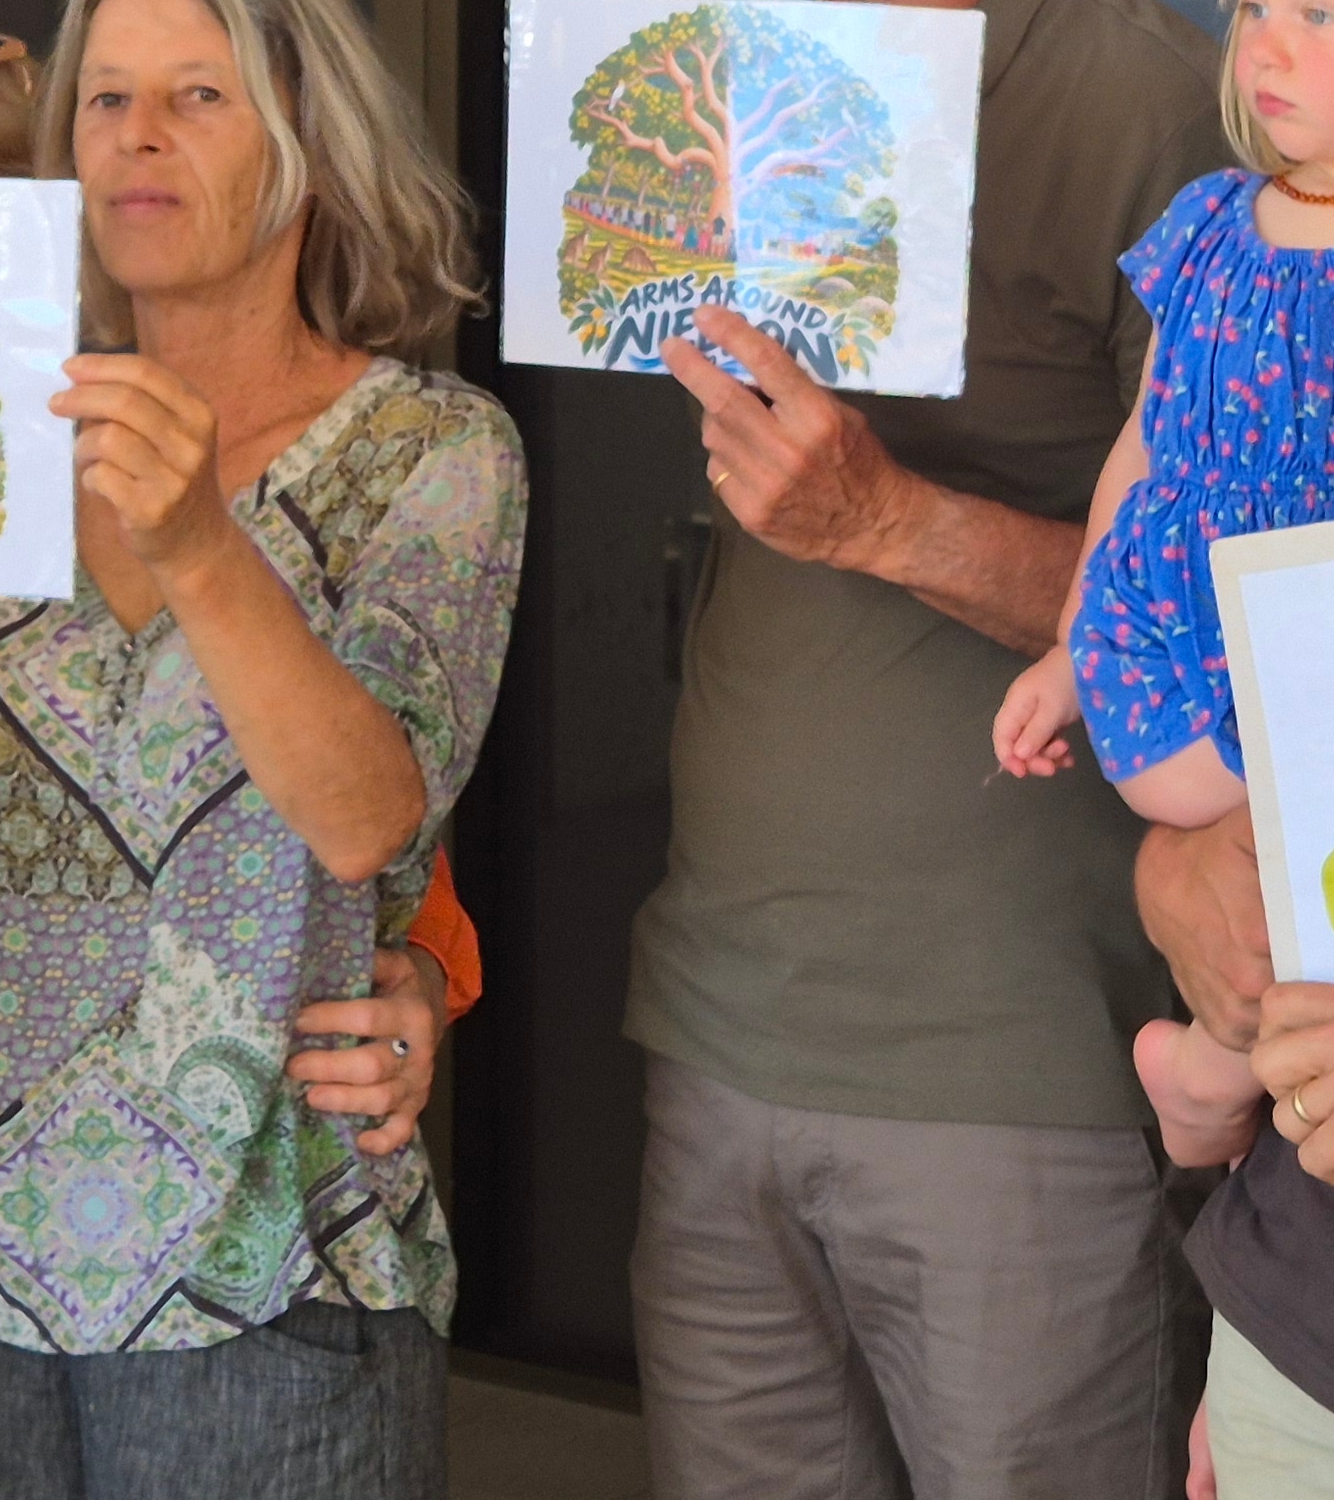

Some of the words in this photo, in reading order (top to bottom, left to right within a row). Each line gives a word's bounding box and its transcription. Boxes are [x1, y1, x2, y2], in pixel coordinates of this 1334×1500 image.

[619, 273, 695, 315] ARMS
[701, 274, 828, 329] AROUND
[605, 306, 839, 386] NIEON
